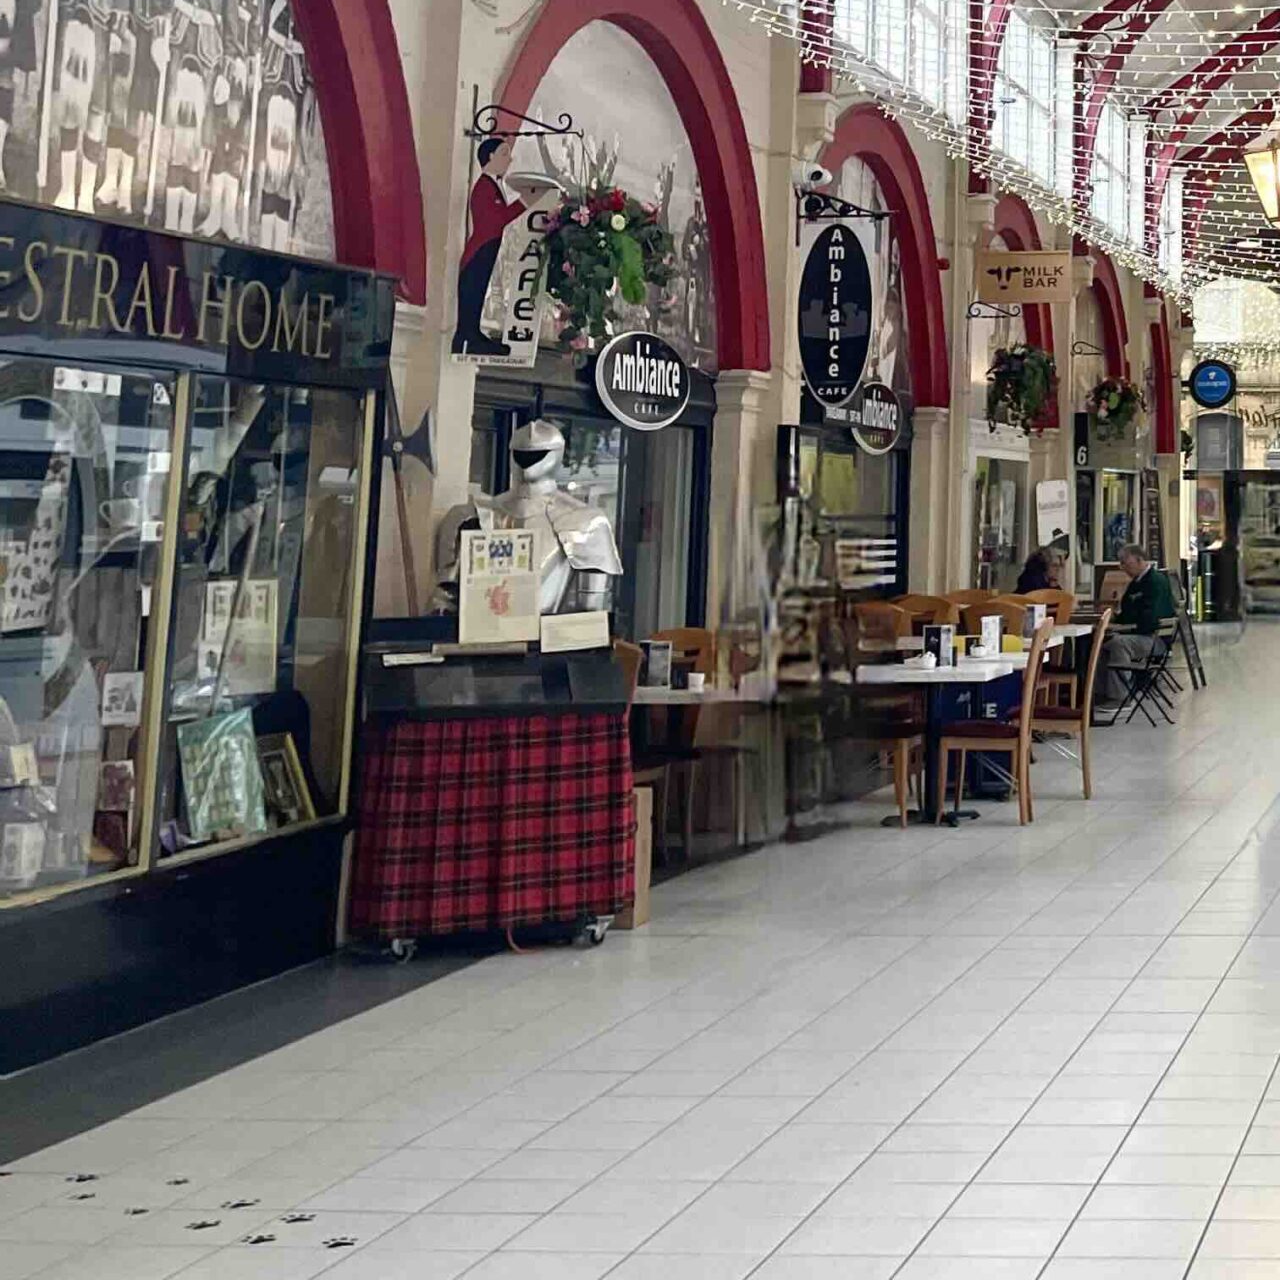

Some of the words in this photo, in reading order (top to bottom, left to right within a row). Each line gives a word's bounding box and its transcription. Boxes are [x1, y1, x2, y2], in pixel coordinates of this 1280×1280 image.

[1023, 266, 1064, 277] MILK
[1023, 278, 1058, 288] BAR
[828, 228, 845, 377] Ambiance
[195, 271, 335, 358] HOME
[612, 341, 681, 398] Ambiance
[817, 387, 848, 396] CAFE
[1077, 446, 1088, 465] 6
